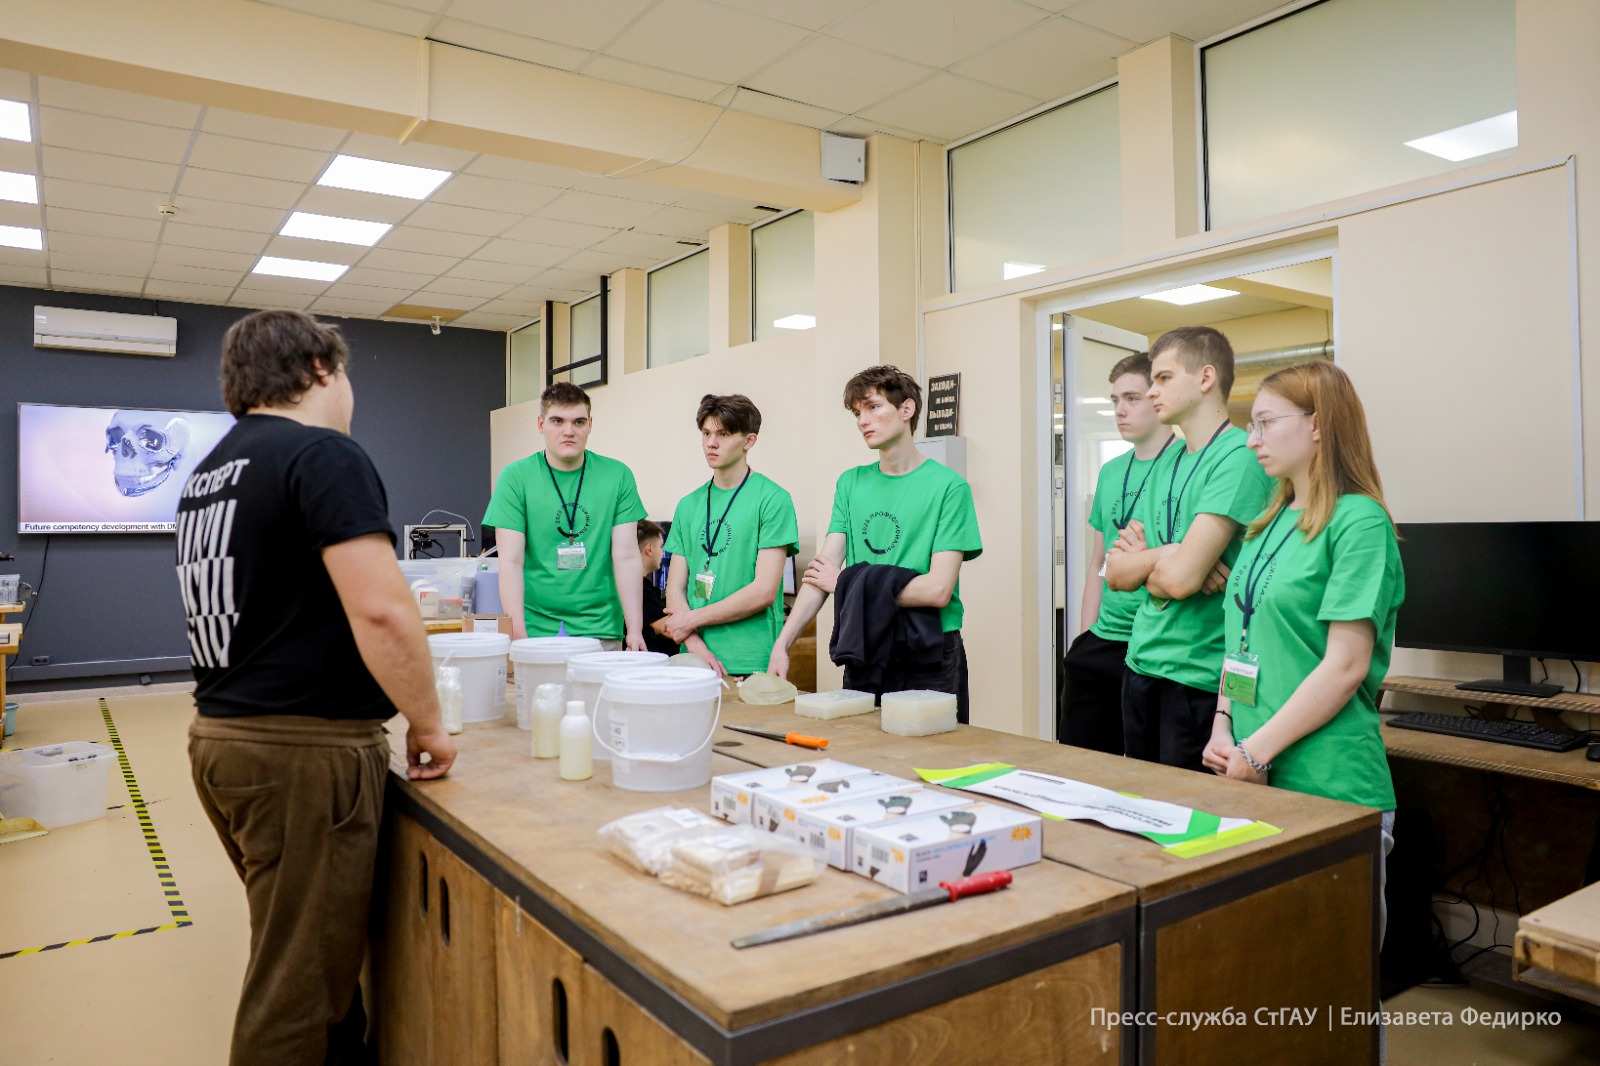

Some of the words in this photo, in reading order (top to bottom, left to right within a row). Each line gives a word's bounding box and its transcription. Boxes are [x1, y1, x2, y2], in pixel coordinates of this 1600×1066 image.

[182, 458, 251, 499] КСПЕРТ
[24, 523, 51, 531] Future
[52, 523, 100, 532] competency
[101, 523, 149, 532] development
[149, 523, 166, 531] with
